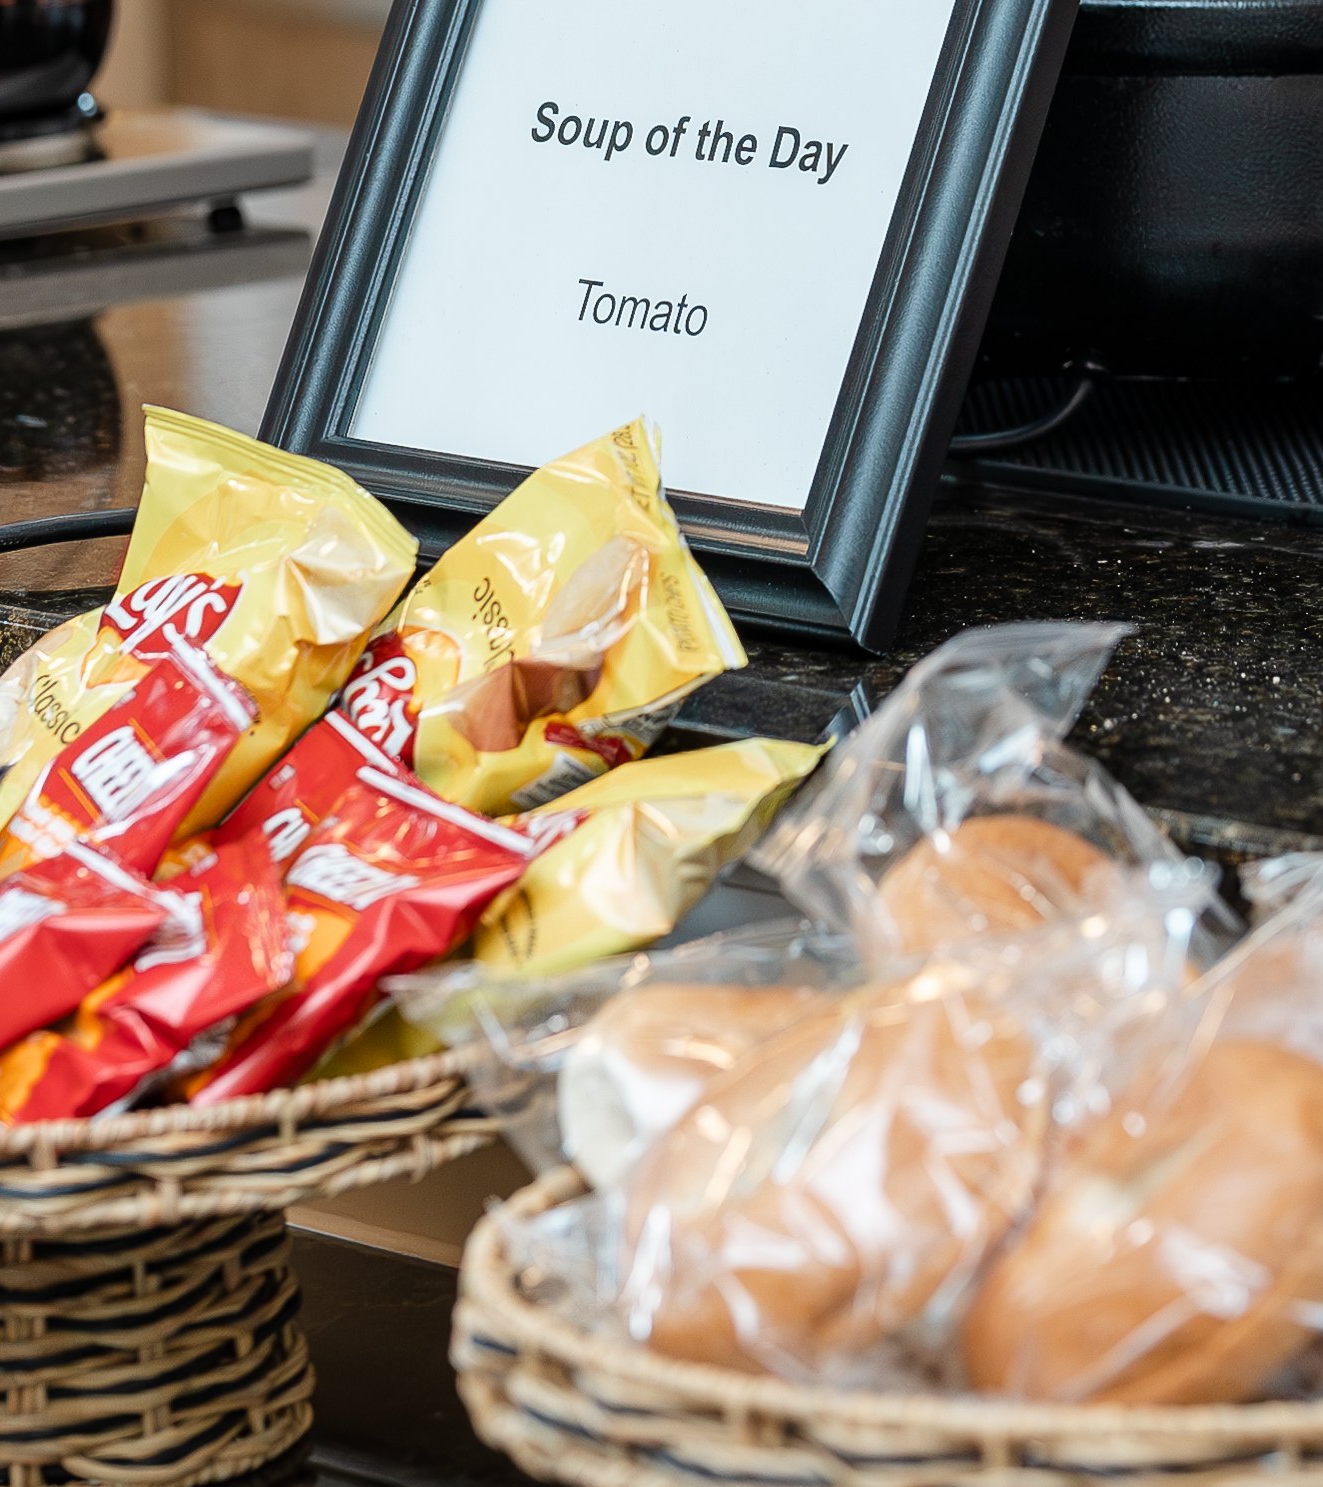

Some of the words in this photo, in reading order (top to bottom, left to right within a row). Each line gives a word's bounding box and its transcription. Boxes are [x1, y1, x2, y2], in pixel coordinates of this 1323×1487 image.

[531, 101, 633, 161] Soup
[645, 116, 692, 157] of
[695, 119, 758, 165] the
[768, 125, 849, 185] Day
[578, 278, 708, 337] Tomato
[105, 573, 227, 656] Lay's
[472, 577, 516, 672] lassic
[340, 652, 416, 758] Lay
